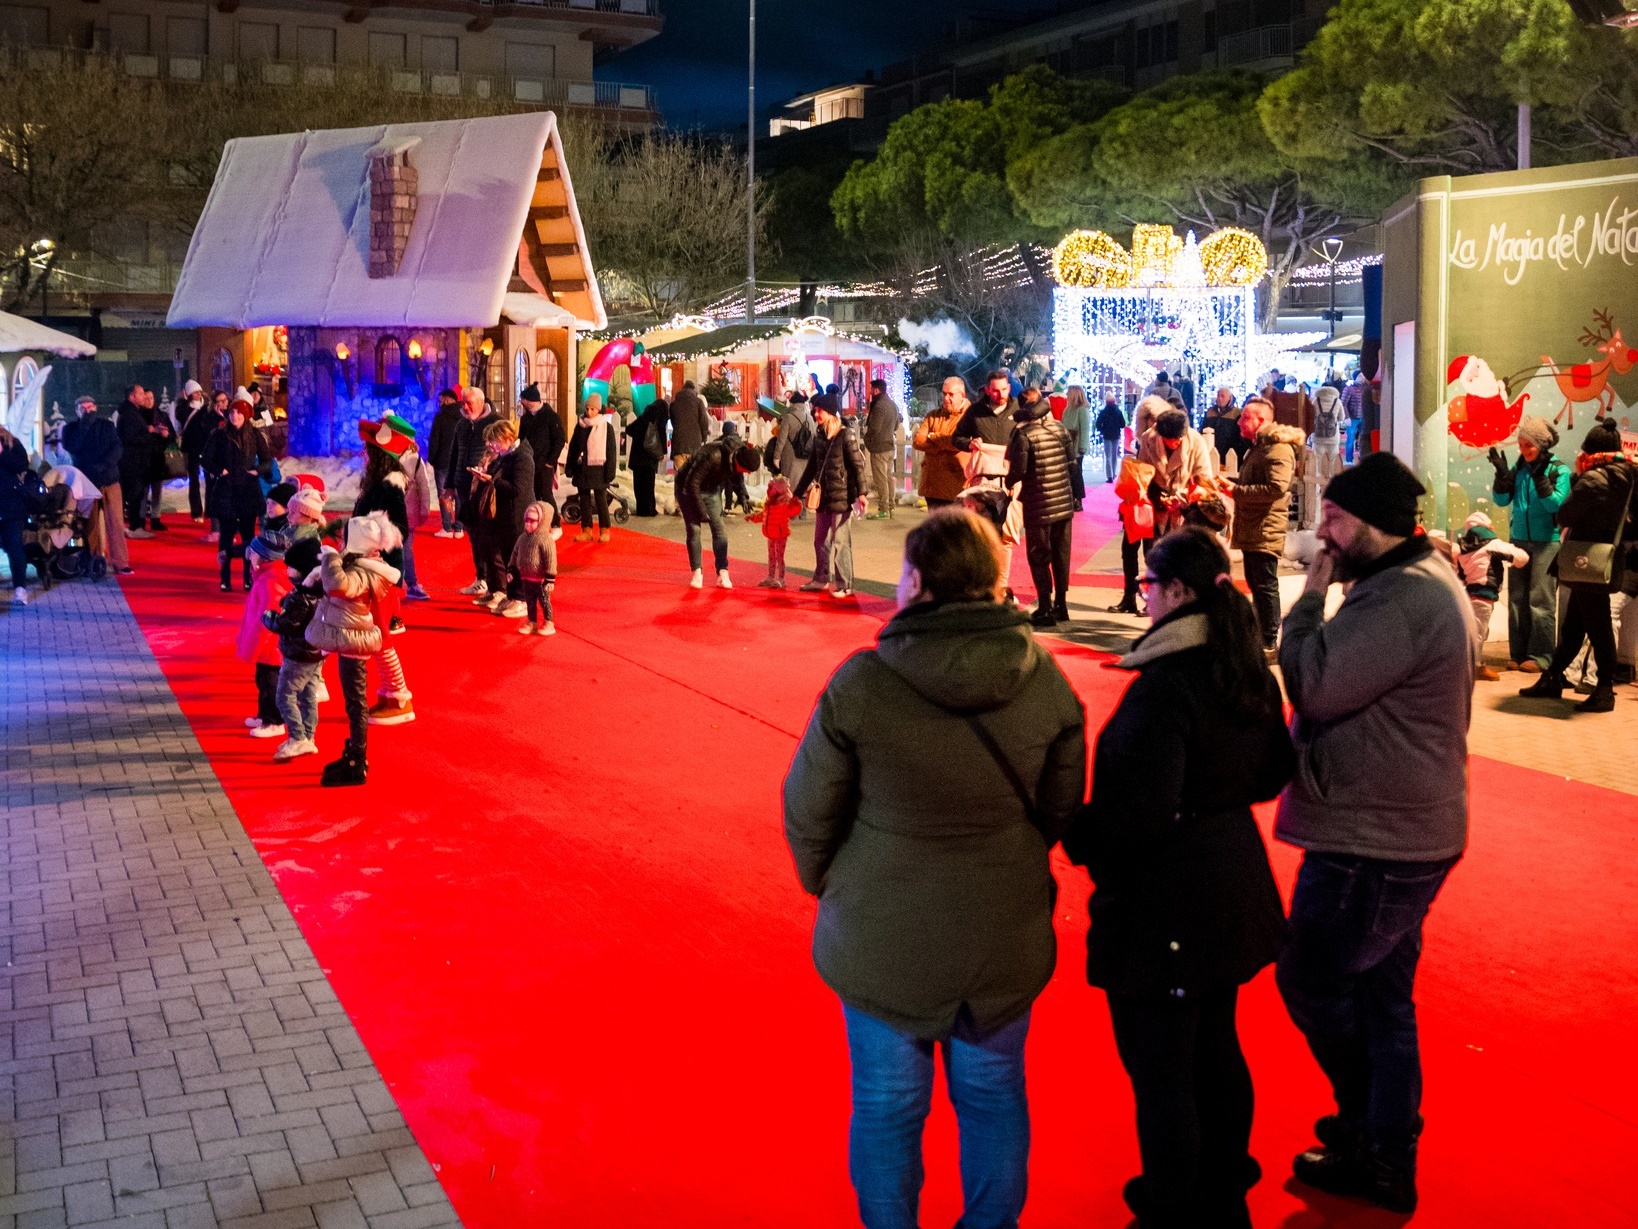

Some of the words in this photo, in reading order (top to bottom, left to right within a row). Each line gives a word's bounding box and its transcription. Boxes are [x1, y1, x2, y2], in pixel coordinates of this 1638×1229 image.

[1449, 229, 1478, 269] La
[1478, 222, 1543, 286] Magia
[1547, 213, 1584, 271] del
[1583, 195, 1638, 267] Nata
[130, 319, 155, 328] MINI
